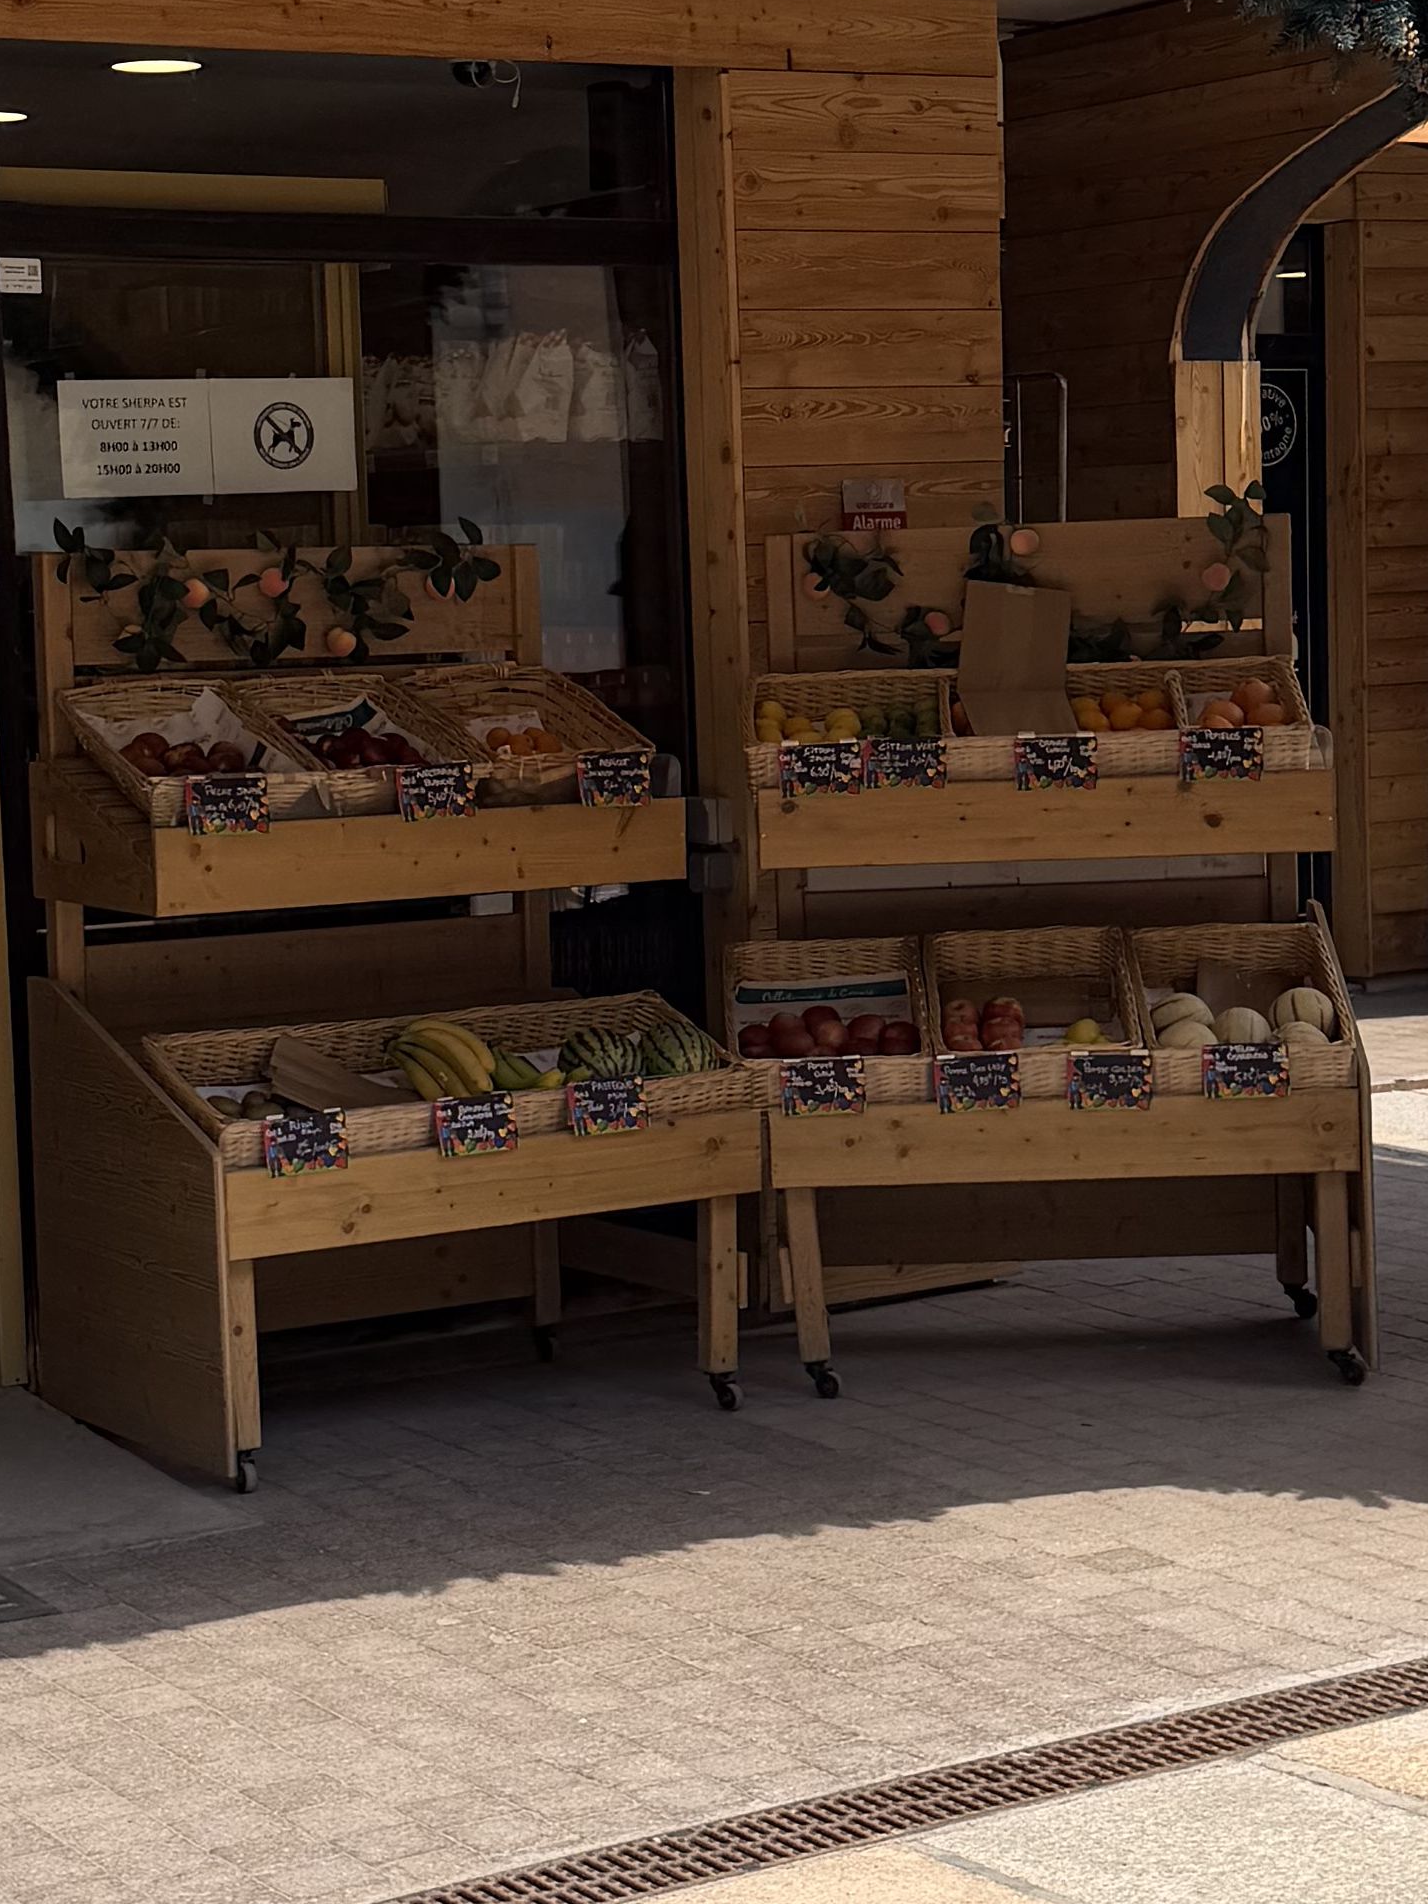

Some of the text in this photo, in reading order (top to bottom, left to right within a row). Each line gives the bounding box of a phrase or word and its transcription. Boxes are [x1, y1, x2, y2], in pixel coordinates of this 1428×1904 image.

[82, 397, 187, 409] VOTRE SHERPA EST
[91, 419, 136, 430] OUVERT
[141, 418, 158, 430] 7/7
[100, 440, 178, 453] 8H00 à 13H00
[97, 462, 181, 476] 15H00 à 20H00
[852, 514, 901, 531] Alarme
